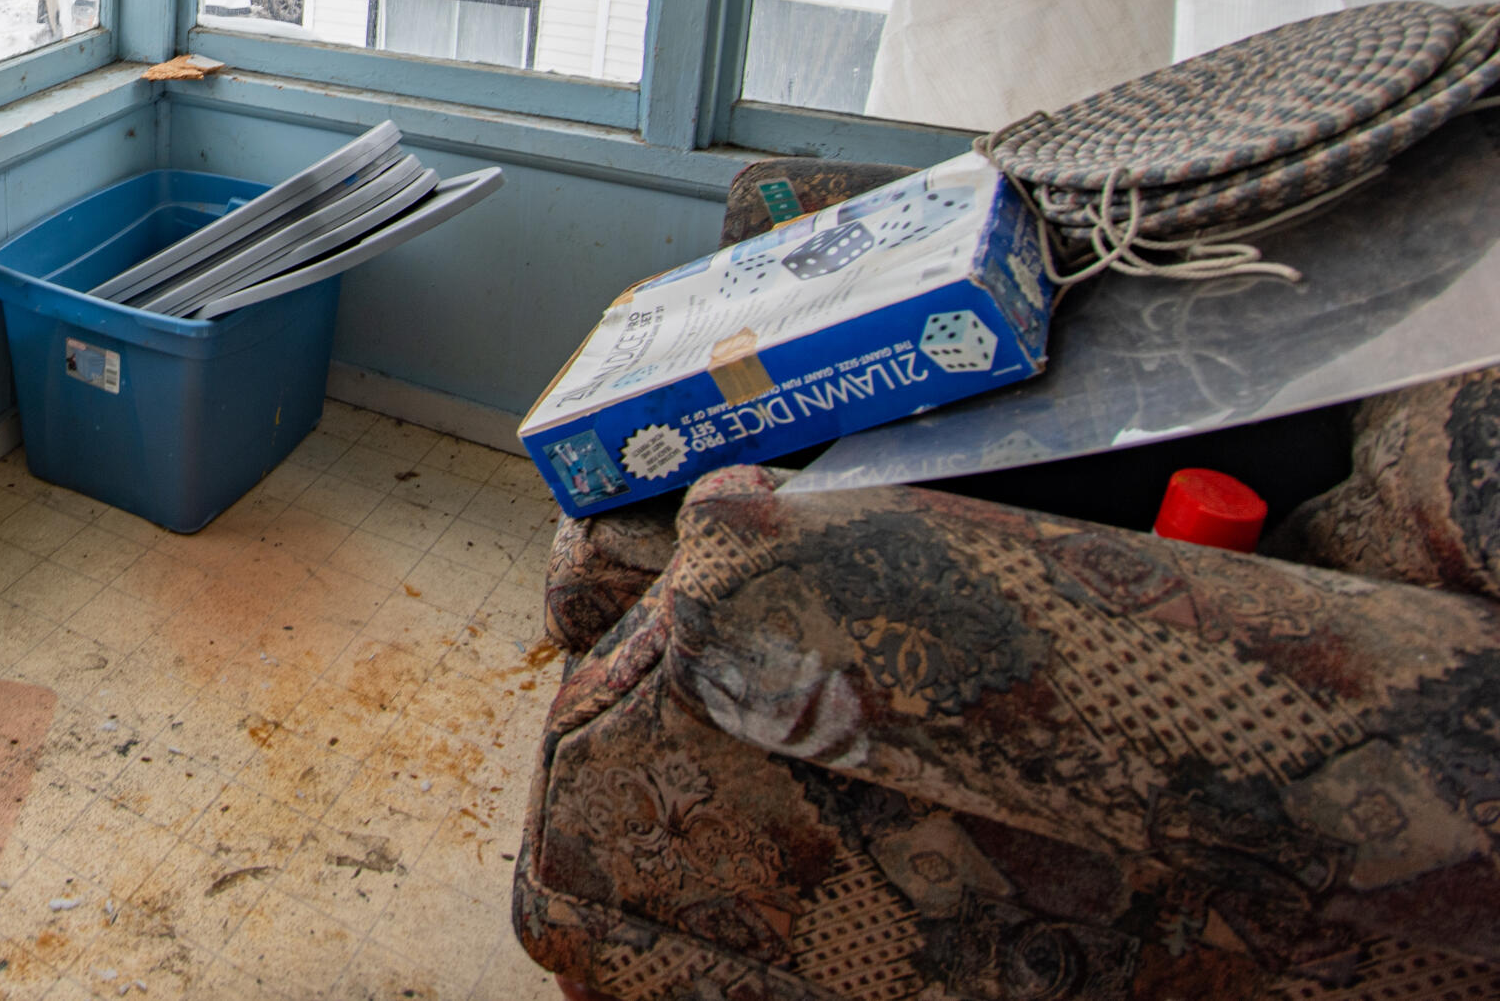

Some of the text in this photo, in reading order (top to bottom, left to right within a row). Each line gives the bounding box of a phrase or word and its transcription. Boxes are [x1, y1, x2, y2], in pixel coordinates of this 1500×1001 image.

[893, 340, 914, 354] THE
[803, 367, 834, 384] GIANT
[889, 351, 929, 386] 21
[781, 377, 802, 391] FUN
[793, 364, 896, 417] LAWN
[681, 414, 692, 425] 21
[693, 410, 706, 421] OF
[721, 397, 796, 440] DICE
[689, 421, 716, 439] SET
[691, 432, 726, 452] PRO
